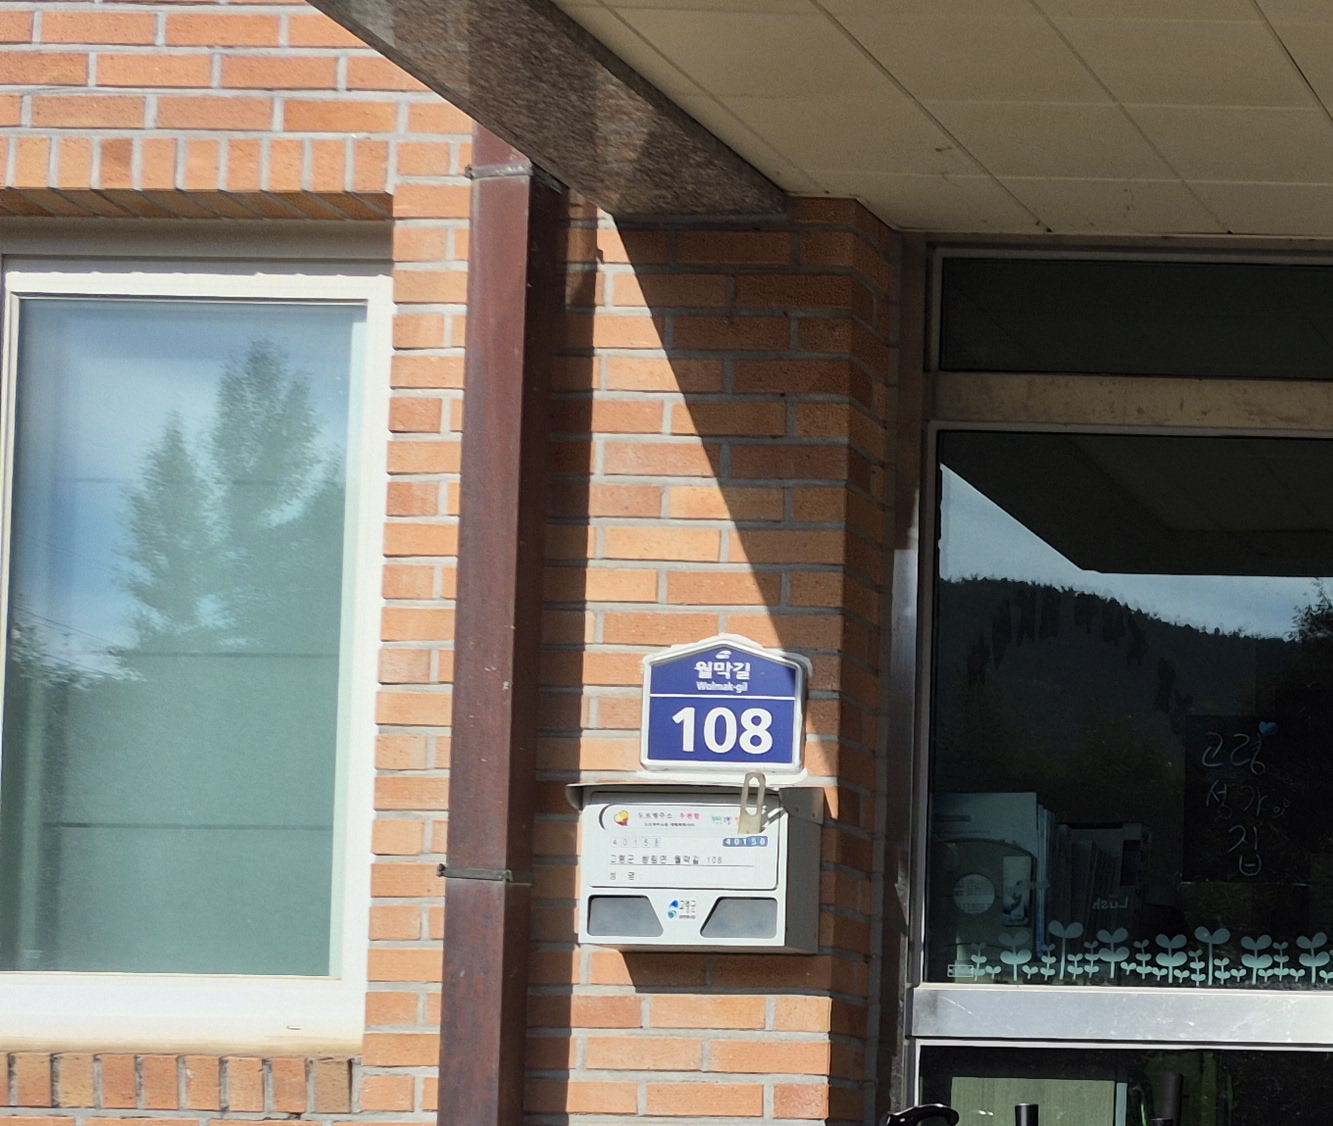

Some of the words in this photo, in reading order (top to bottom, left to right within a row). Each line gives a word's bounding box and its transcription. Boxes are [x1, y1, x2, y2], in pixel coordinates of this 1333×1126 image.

[694, 661, 751, 679] 월막길
[696, 681, 748, 693] Wolmak-gil
[672, 707, 773, 754] 108
